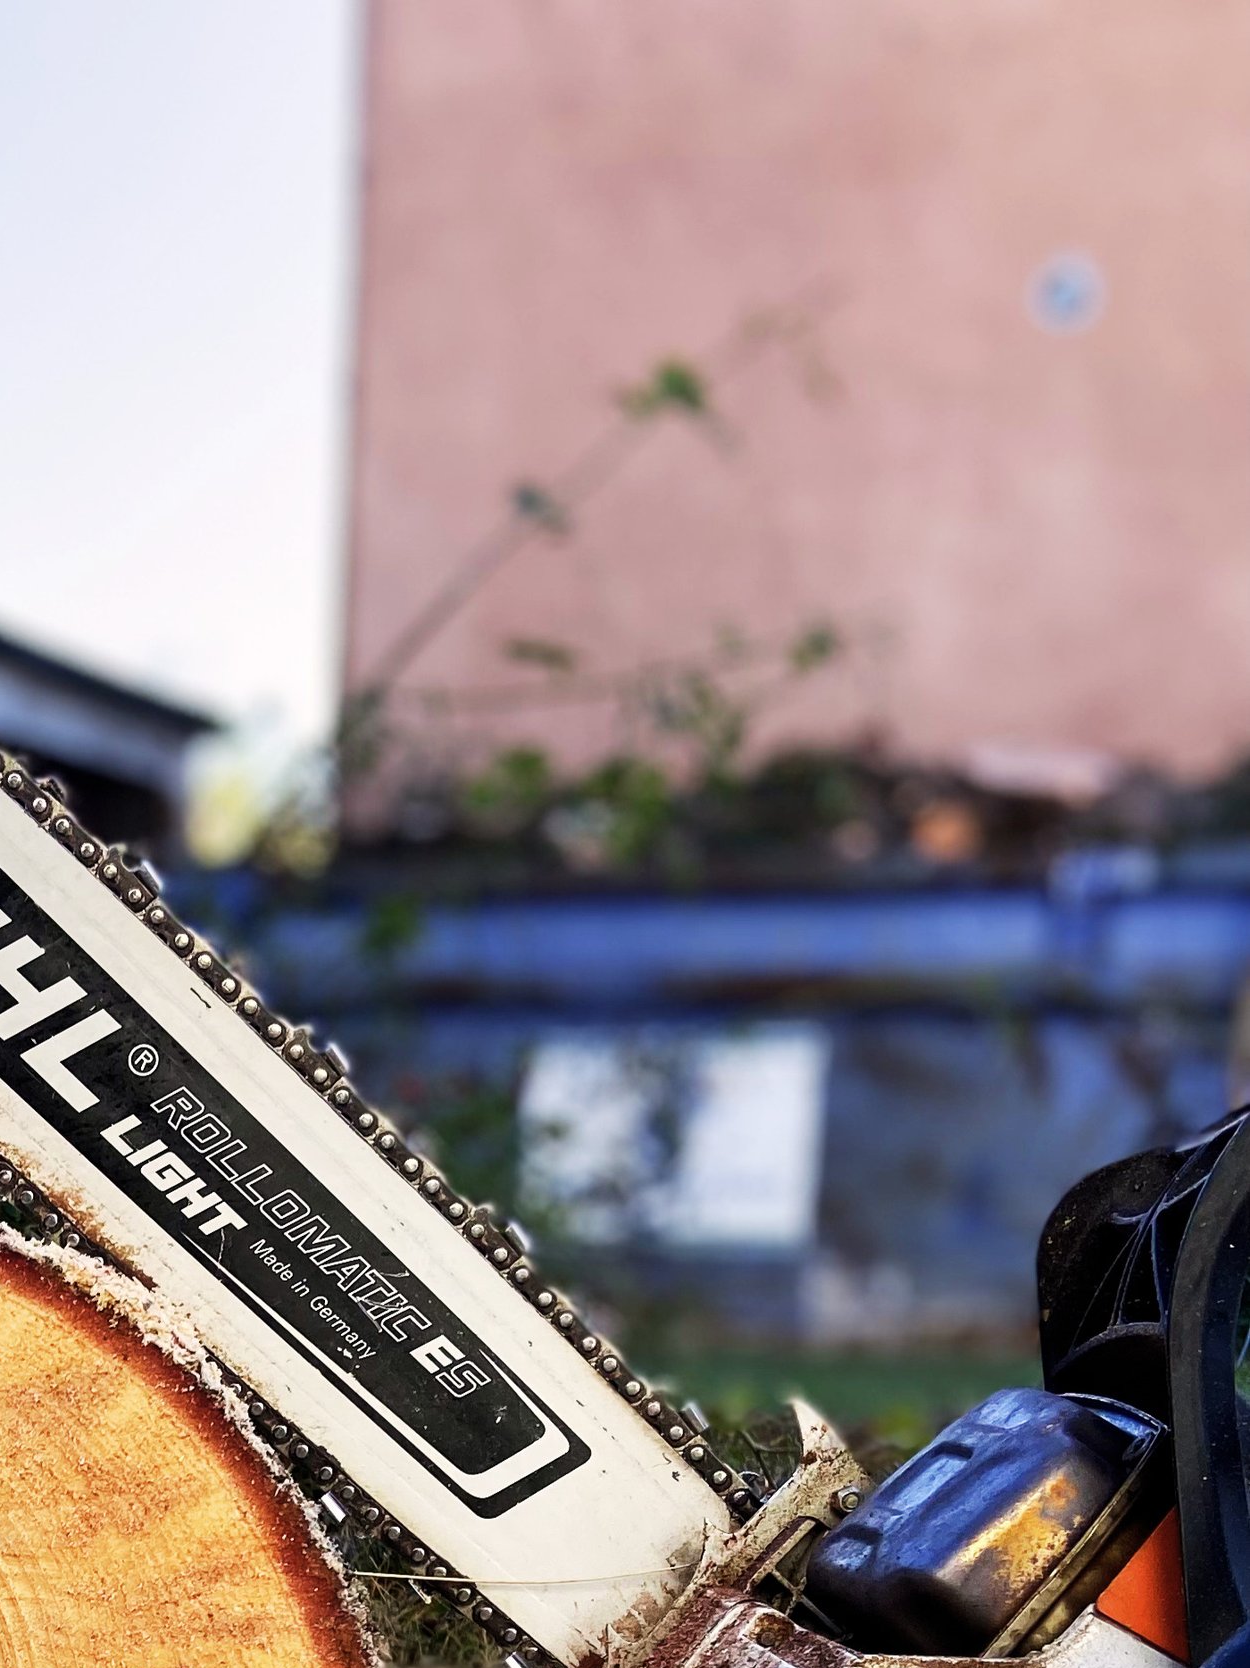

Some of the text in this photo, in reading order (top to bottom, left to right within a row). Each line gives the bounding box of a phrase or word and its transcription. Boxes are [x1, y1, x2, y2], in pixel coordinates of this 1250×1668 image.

[100, 1114, 248, 1236] LIGHT
[150, 1086, 492, 1399] ROLLOMATIC ES
[249, 1238, 377, 1360] Made in Germany
